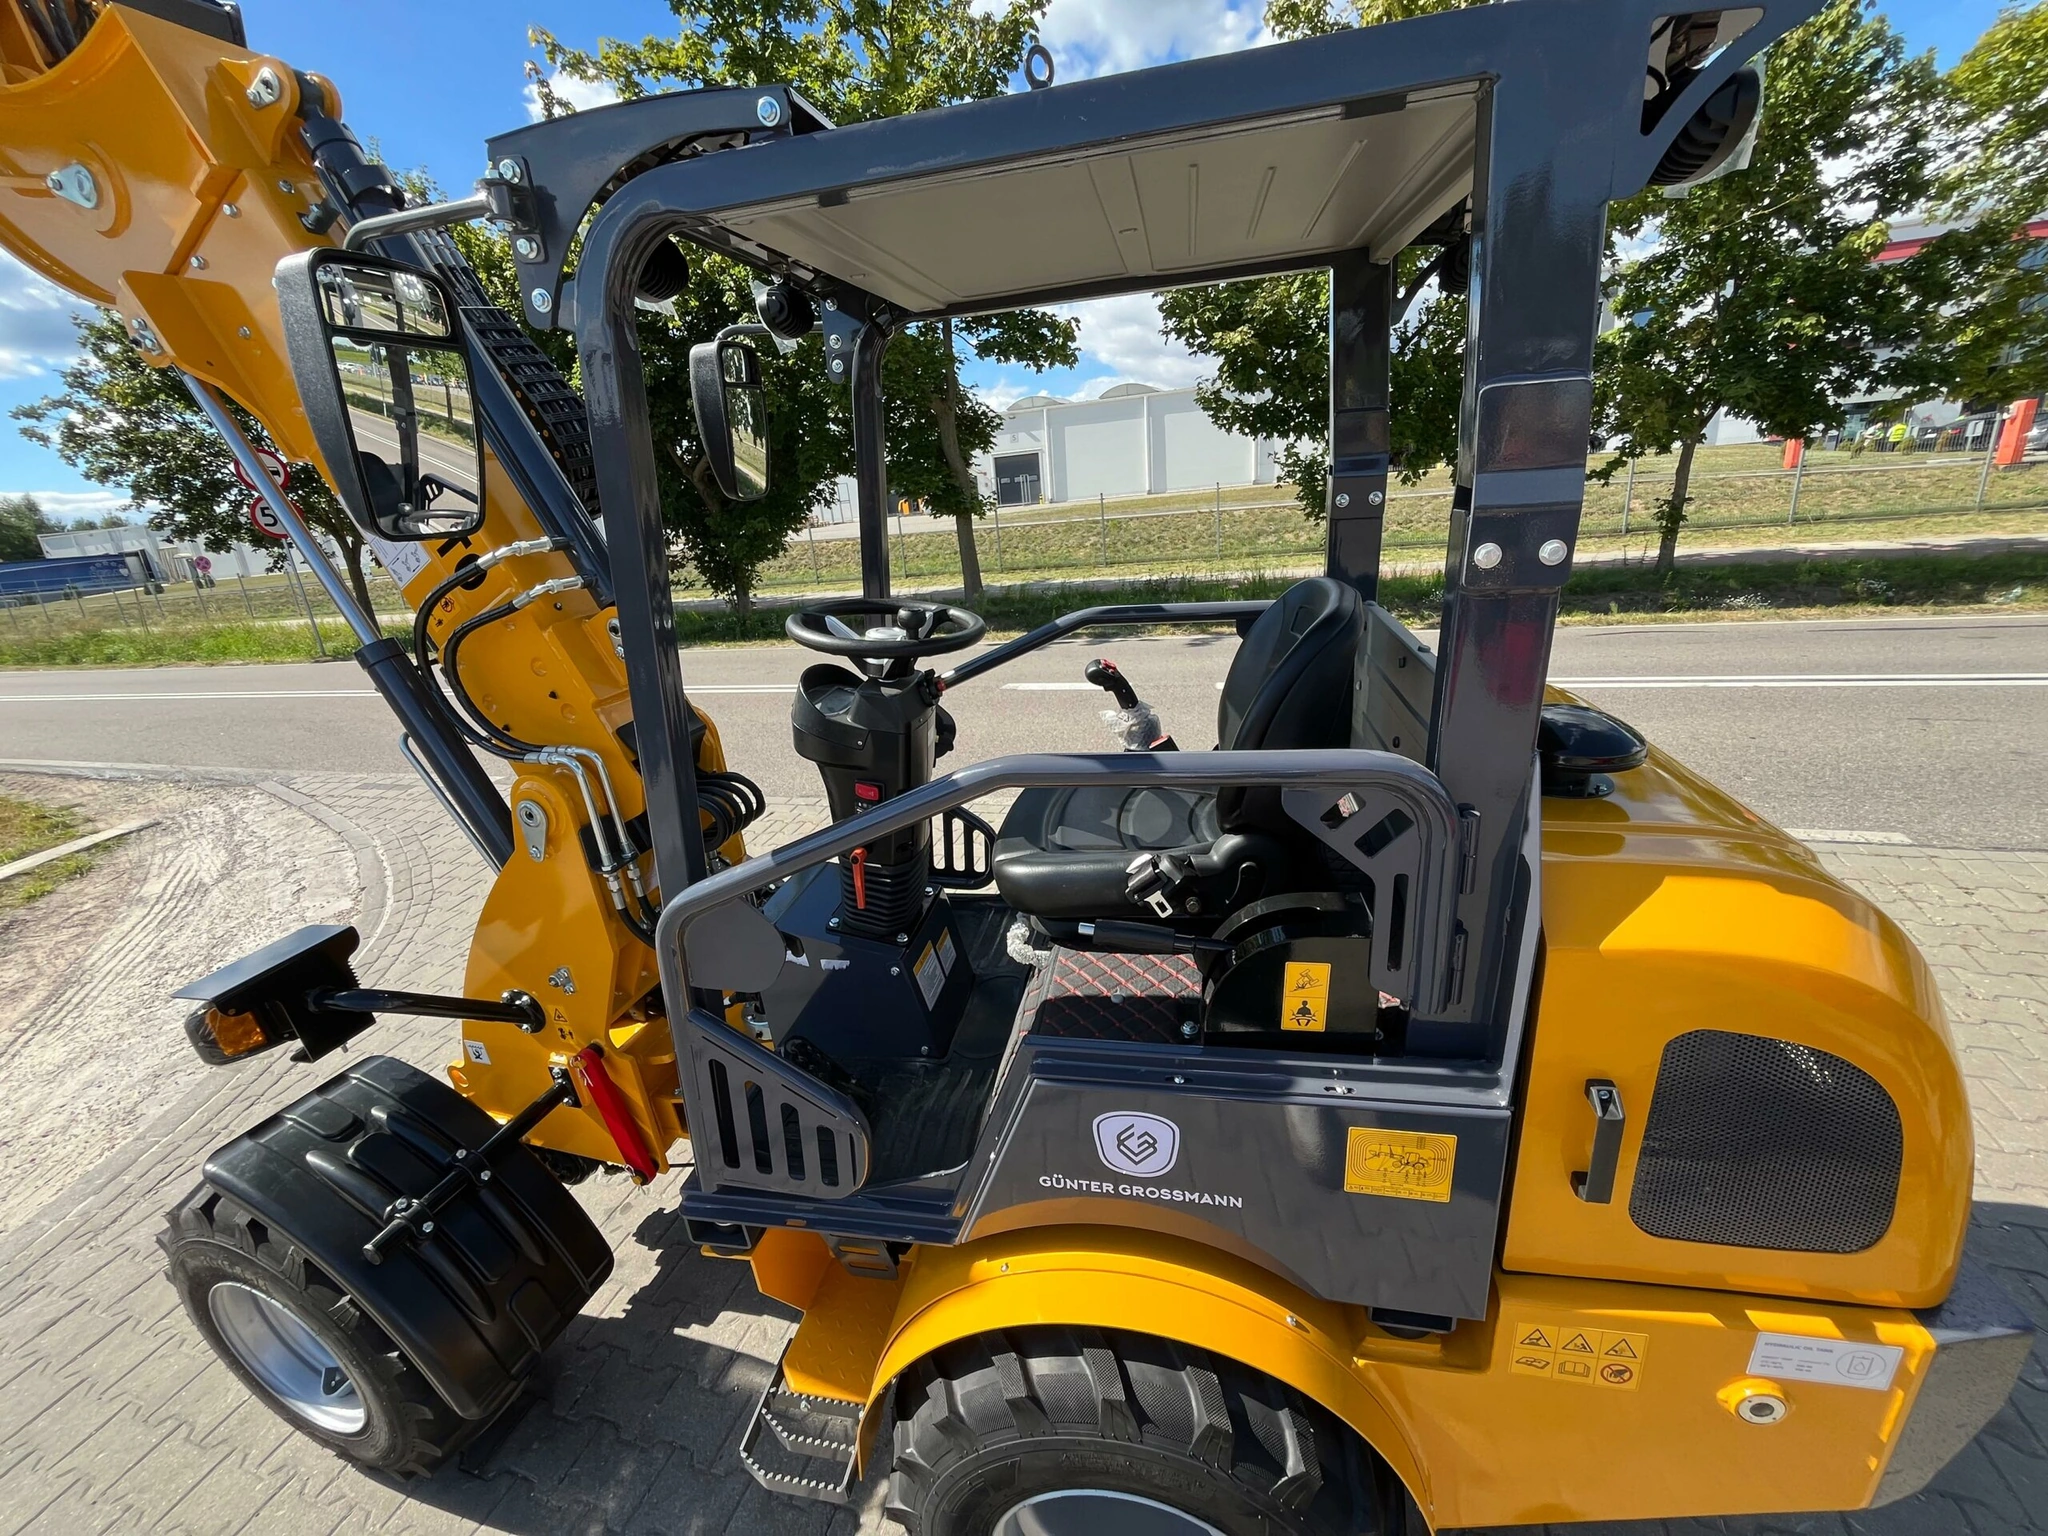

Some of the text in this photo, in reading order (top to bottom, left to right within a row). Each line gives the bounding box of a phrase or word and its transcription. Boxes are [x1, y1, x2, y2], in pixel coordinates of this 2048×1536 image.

[260, 506, 278, 527] 5
[1038, 1174, 1243, 1209] GÜNTER GROSSMANN
